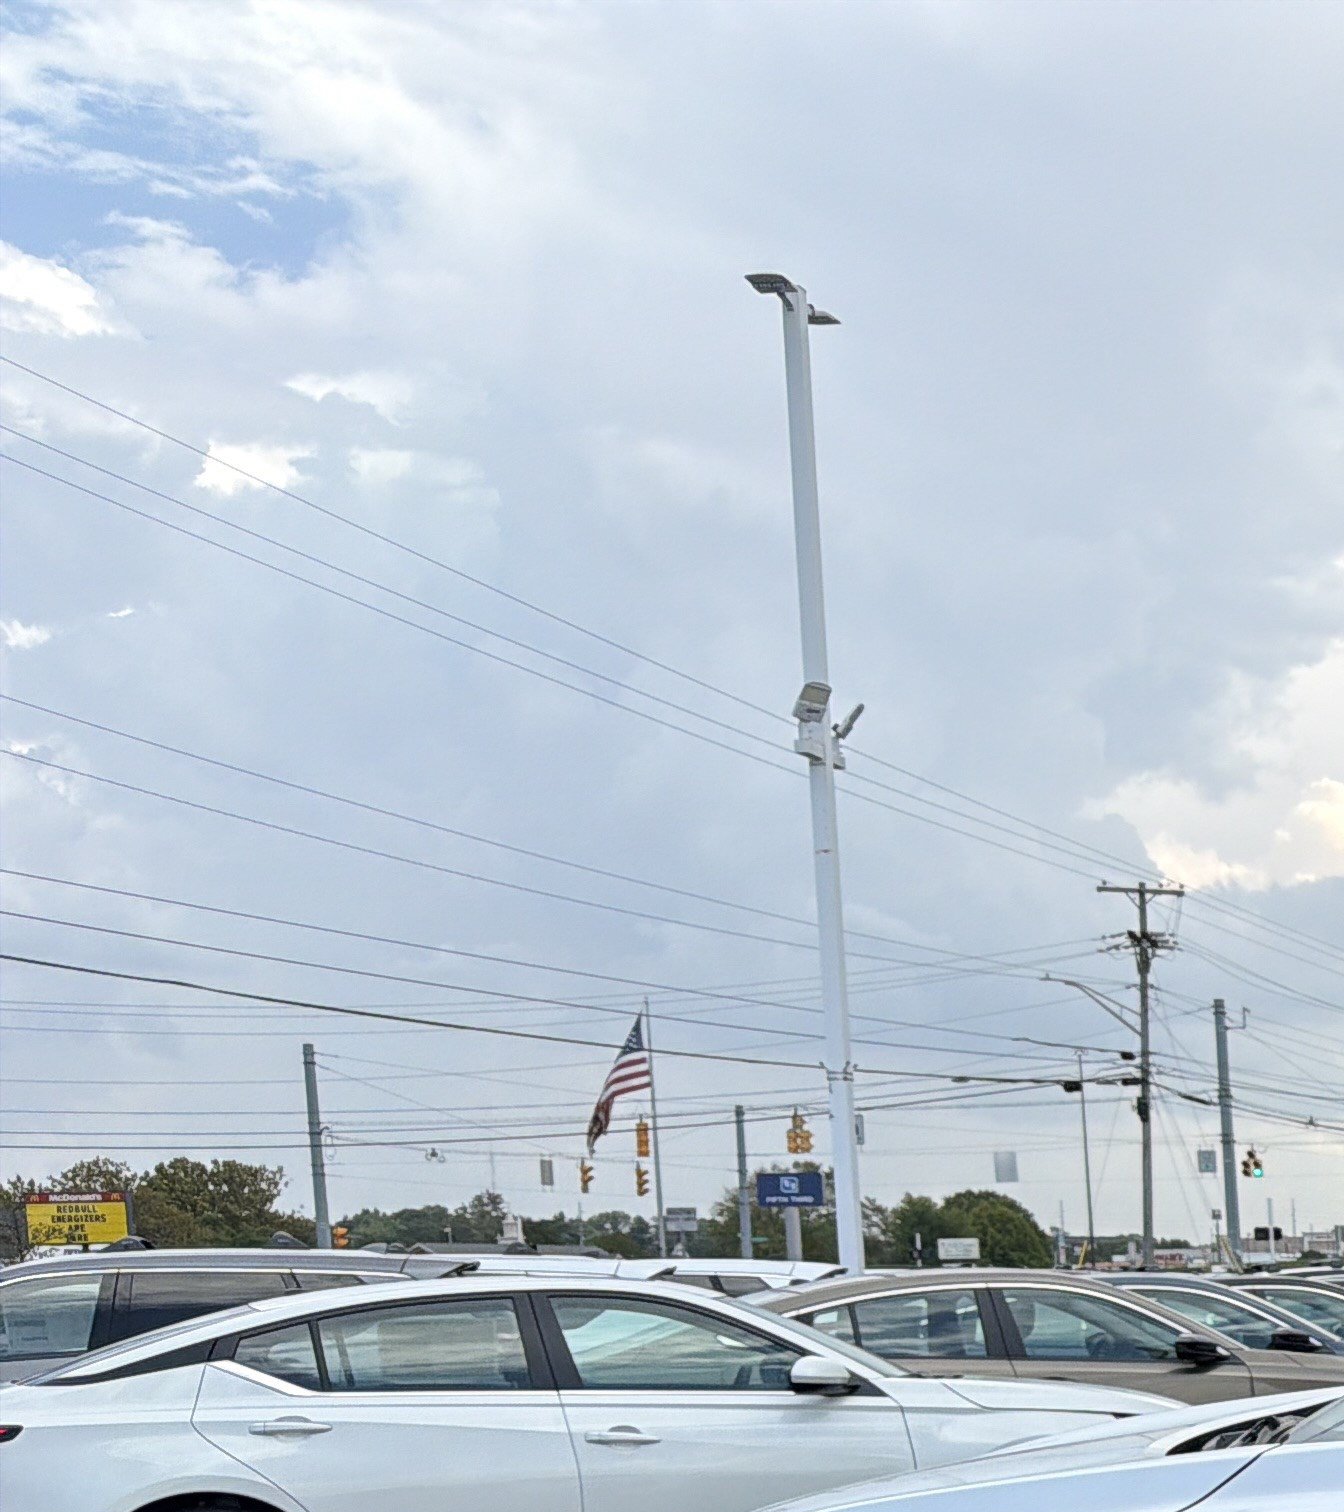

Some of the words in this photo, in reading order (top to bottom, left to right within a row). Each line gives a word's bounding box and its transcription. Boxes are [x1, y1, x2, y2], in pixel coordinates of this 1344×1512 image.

[48, 1193, 103, 1202] McDonald's
[56, 1204, 98, 1214] REDBULL
[51, 1214, 107, 1223] ENERGIZERS
